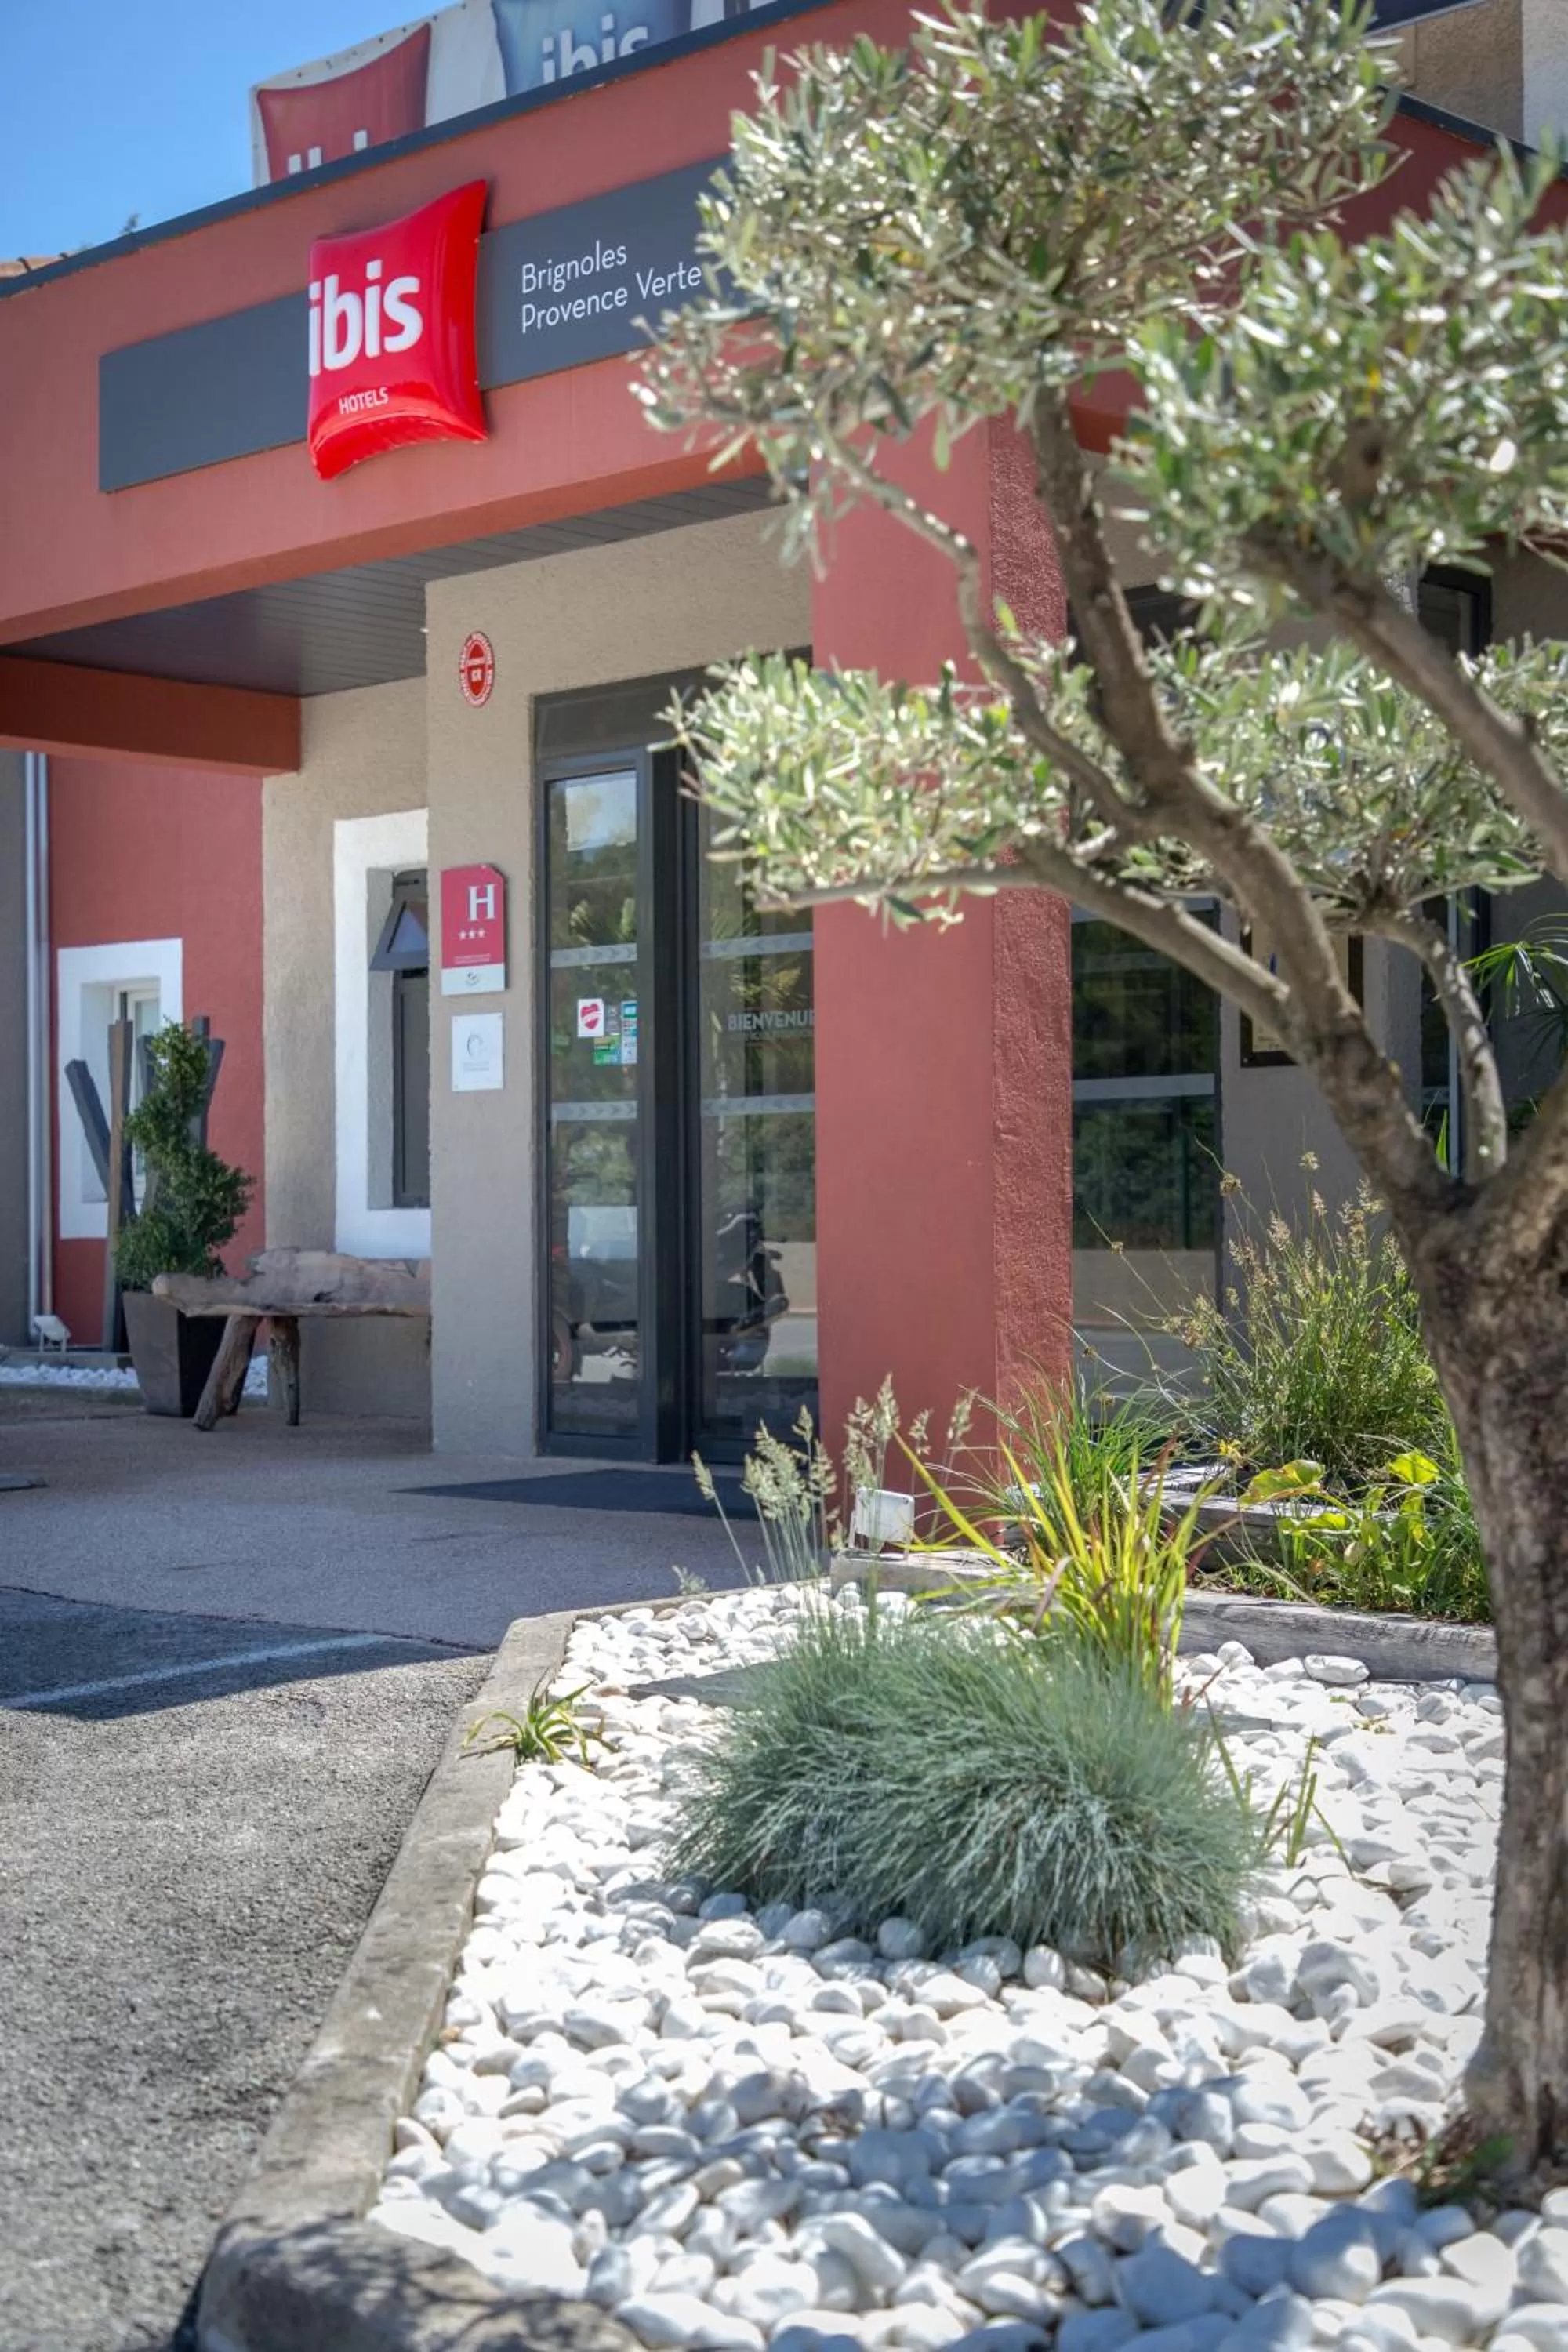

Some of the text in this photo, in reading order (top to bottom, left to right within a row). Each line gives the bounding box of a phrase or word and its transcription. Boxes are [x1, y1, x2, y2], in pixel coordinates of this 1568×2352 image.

[521, 240, 627, 294] Brignoles
[308, 259, 423, 377] ibis
[521, 260, 702, 334] Provence Verte
[339, 387, 389, 415] HOTELS
[468, 884, 497, 921] H
